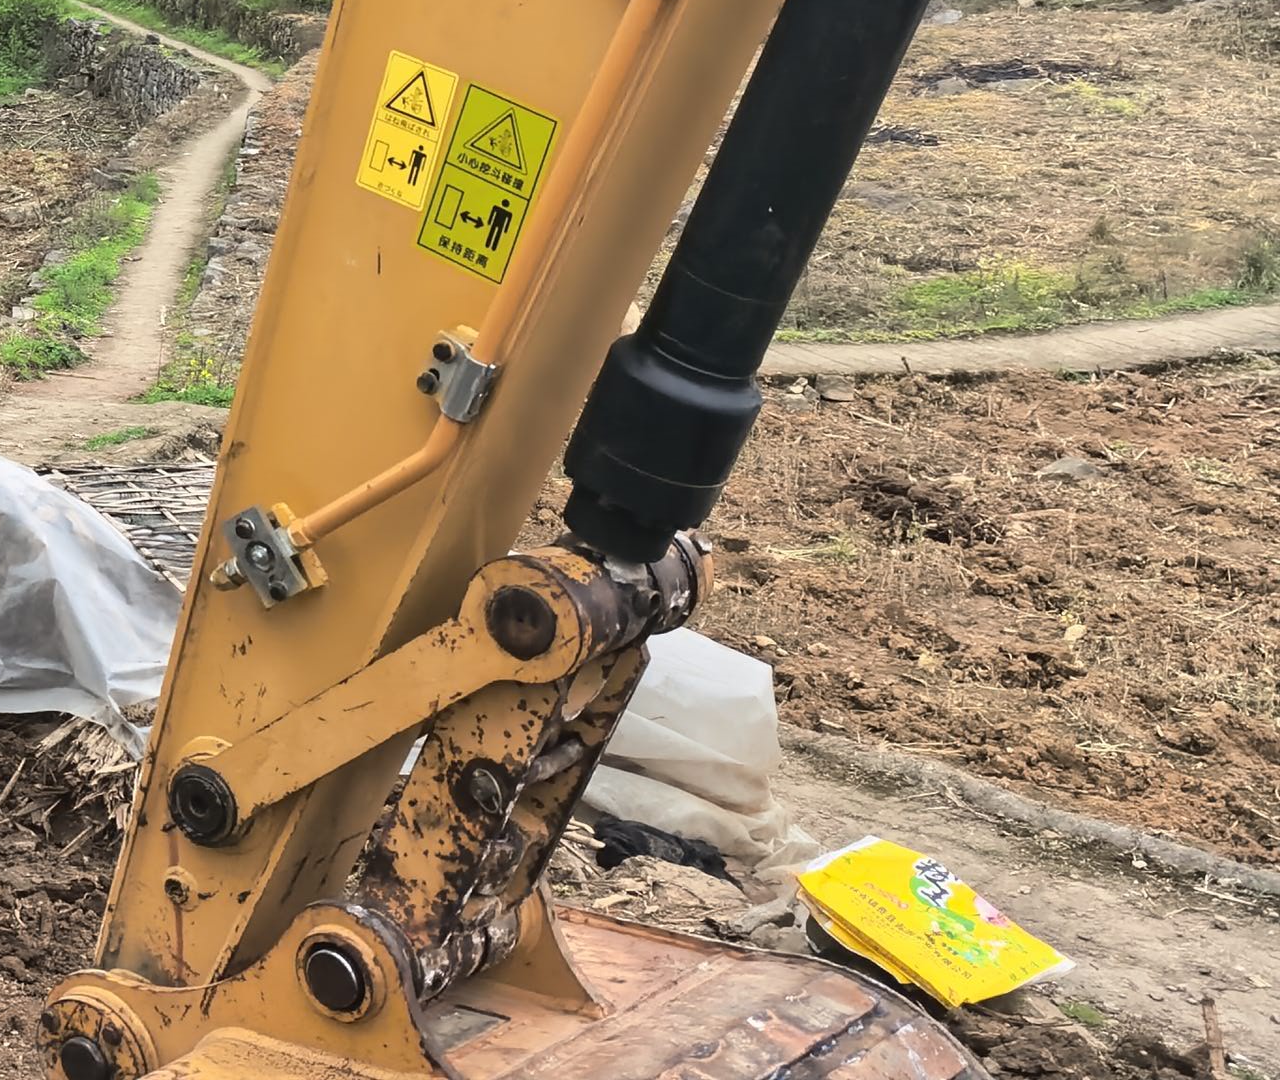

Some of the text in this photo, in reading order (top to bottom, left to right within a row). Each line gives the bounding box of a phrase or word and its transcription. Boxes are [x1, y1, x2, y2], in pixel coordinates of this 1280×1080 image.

[456, 152, 525, 192] 小心挖斗碰撞
[437, 234, 489, 269] 保持距离
